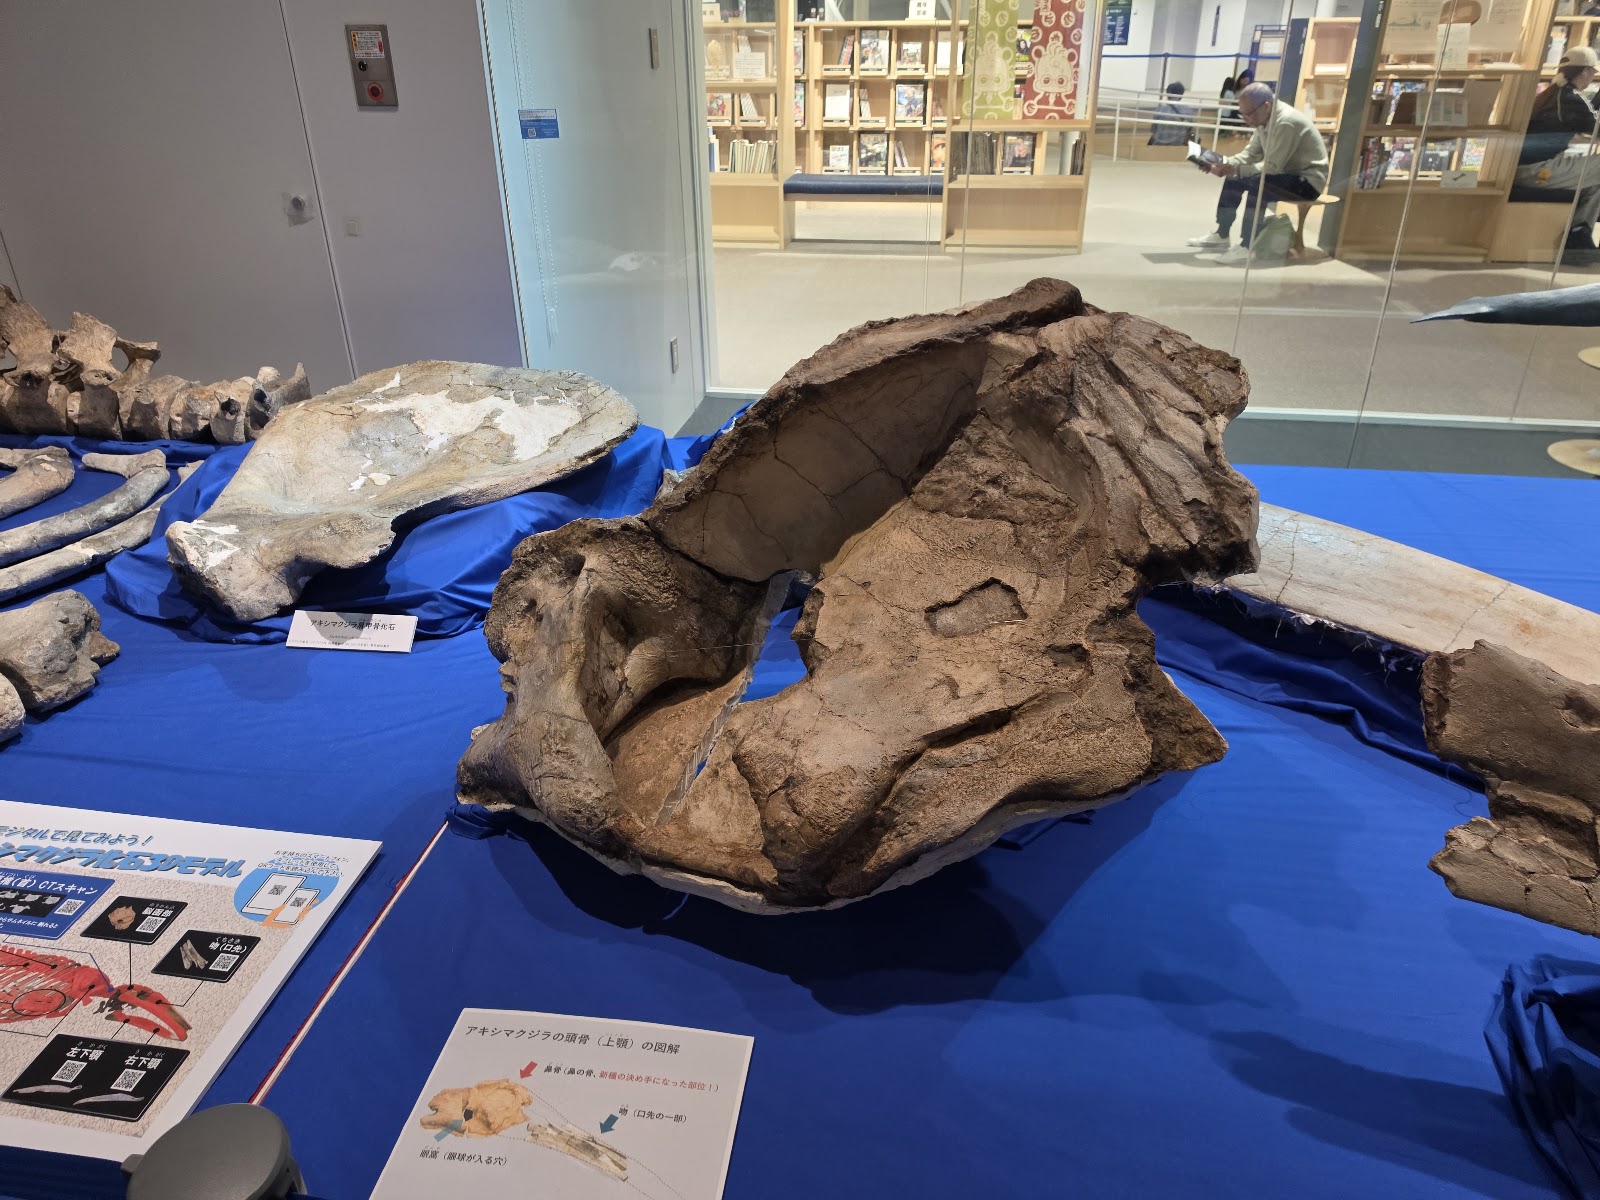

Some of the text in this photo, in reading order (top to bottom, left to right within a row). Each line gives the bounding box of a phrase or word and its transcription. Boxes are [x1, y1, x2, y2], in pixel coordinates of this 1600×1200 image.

[65, 1046, 105, 1061] 左下顎
[124, 1054, 163, 1070] 右下顎
